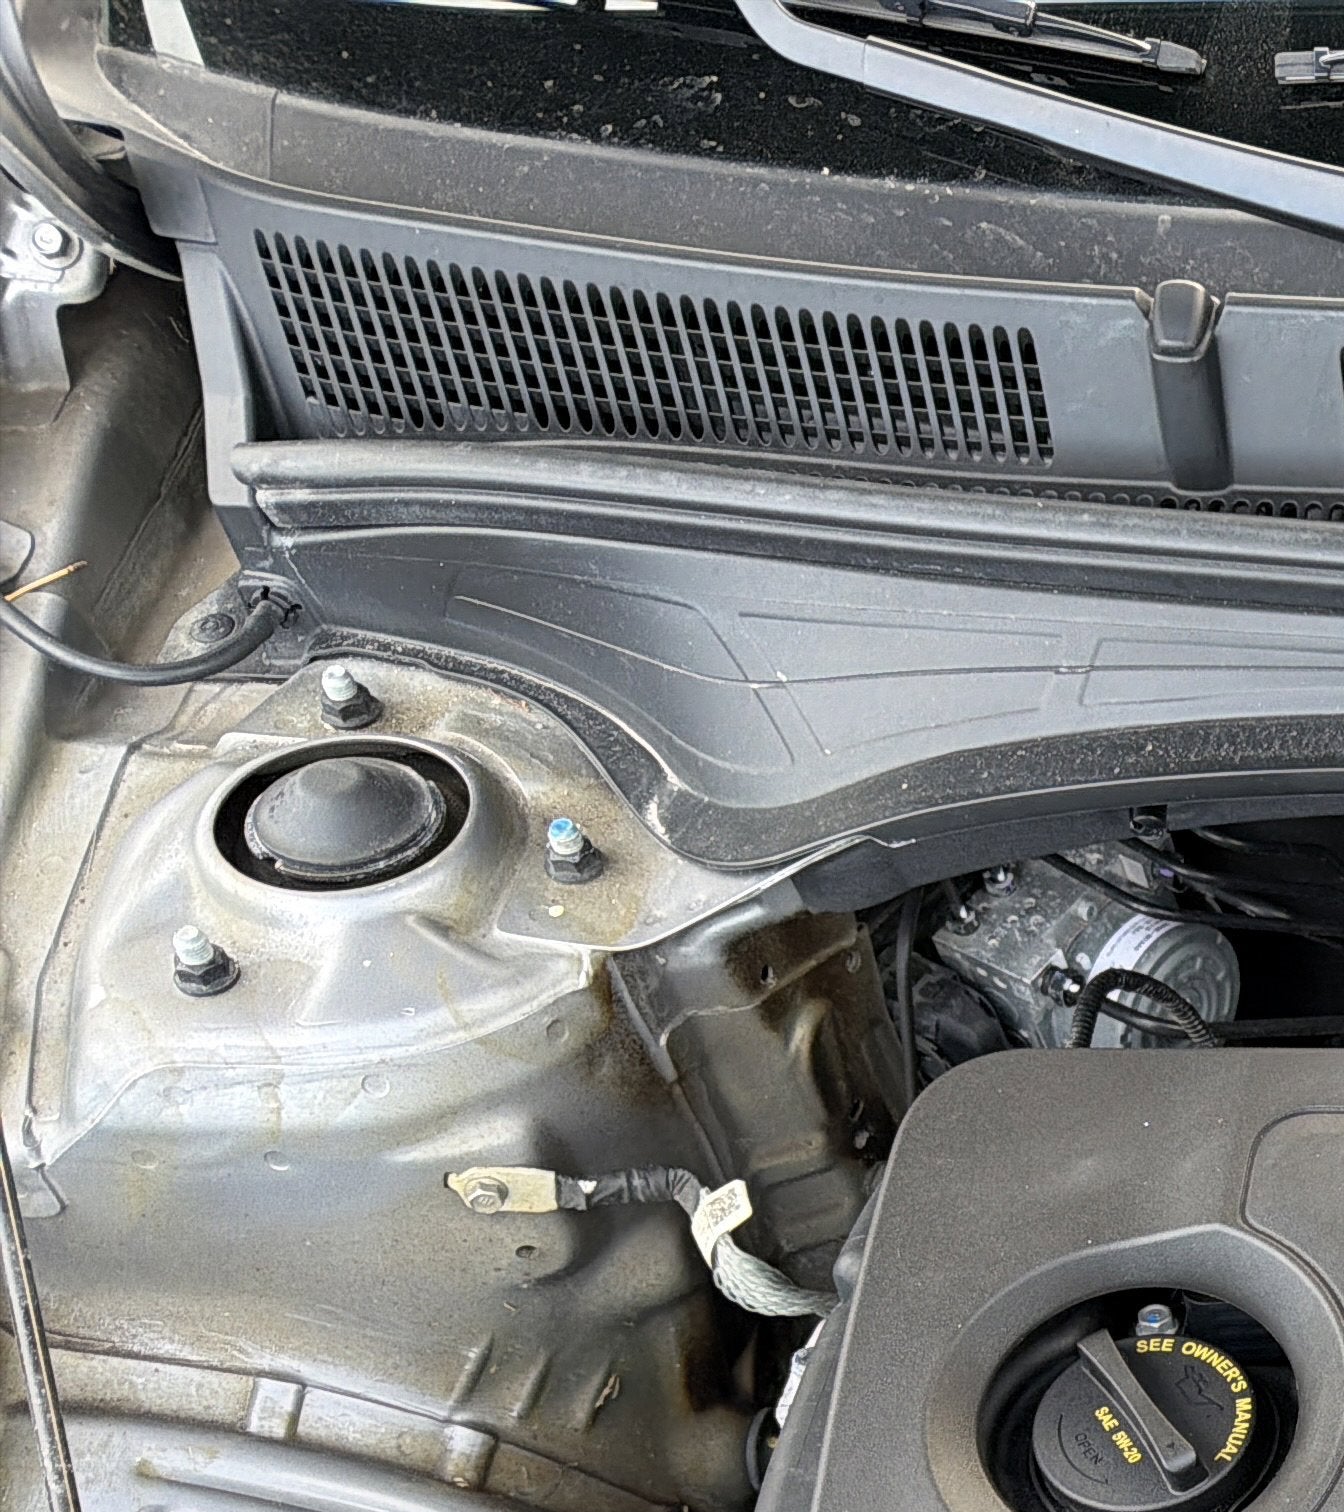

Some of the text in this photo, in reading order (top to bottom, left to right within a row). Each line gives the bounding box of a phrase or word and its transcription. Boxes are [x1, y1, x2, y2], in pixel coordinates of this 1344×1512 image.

[1136, 1338, 1253, 1462] SEE OWNER'S MANUAL
[1074, 1432, 1104, 1465] OPEN
[1094, 1406, 1142, 1464] SAE 5W-20
